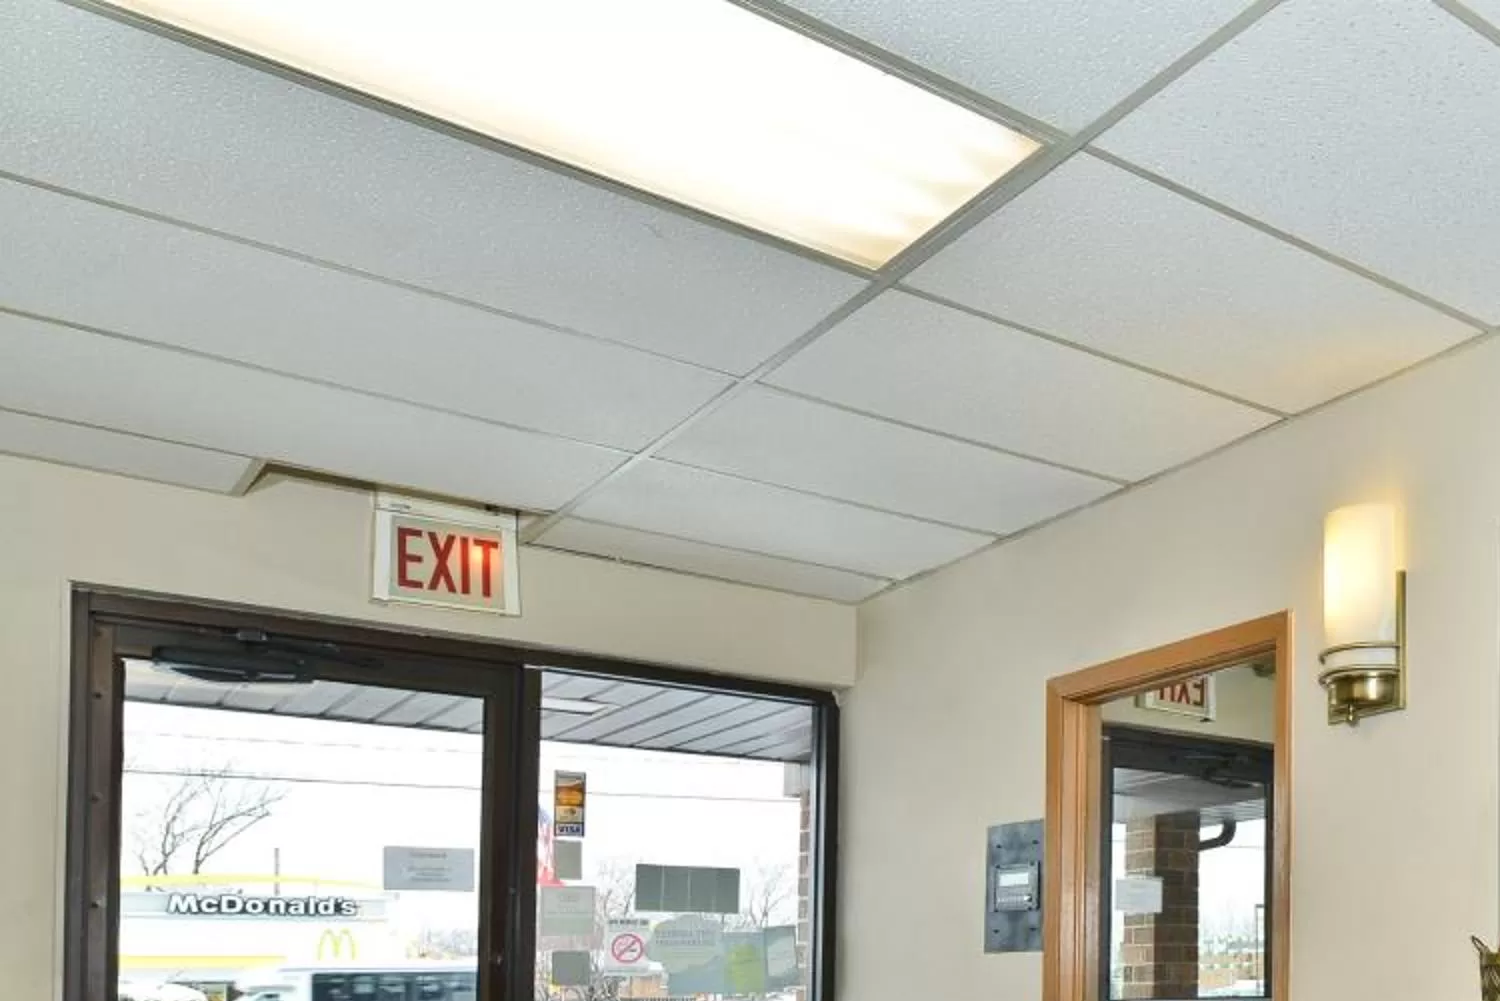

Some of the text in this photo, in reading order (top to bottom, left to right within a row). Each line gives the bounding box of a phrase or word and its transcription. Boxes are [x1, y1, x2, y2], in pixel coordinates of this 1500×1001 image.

[397, 526, 499, 598] EXIT
[558, 825, 581, 833] VISA
[167, 893, 358, 916] McDonald's
